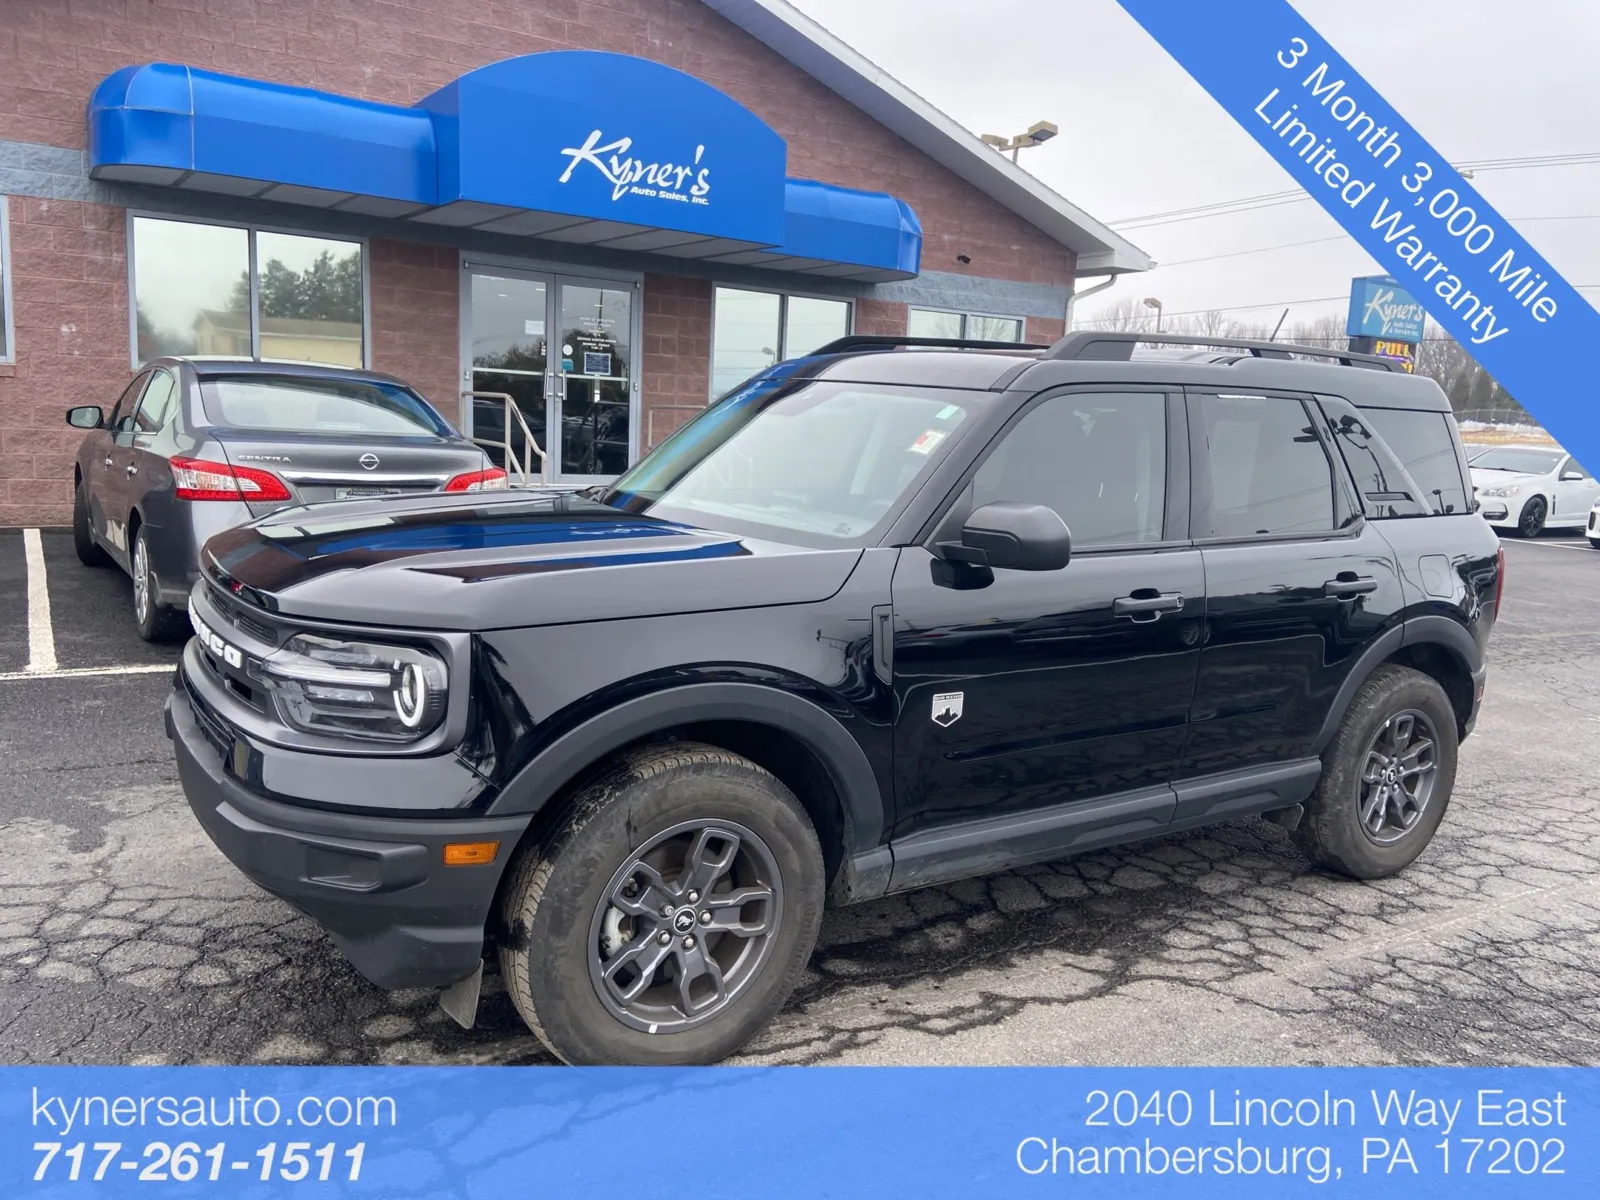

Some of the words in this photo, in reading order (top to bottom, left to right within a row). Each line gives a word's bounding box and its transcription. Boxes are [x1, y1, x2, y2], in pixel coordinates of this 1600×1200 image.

[558, 129, 711, 201] Kyner's
[629, 186, 657, 197] Auto
[658, 190, 689, 203] Sales,
[691, 195, 710, 206] Inc.
[1362, 287, 1424, 336] Kyners
[1375, 340, 1410, 357] PULL
[237, 454, 292, 463] SENTRA
